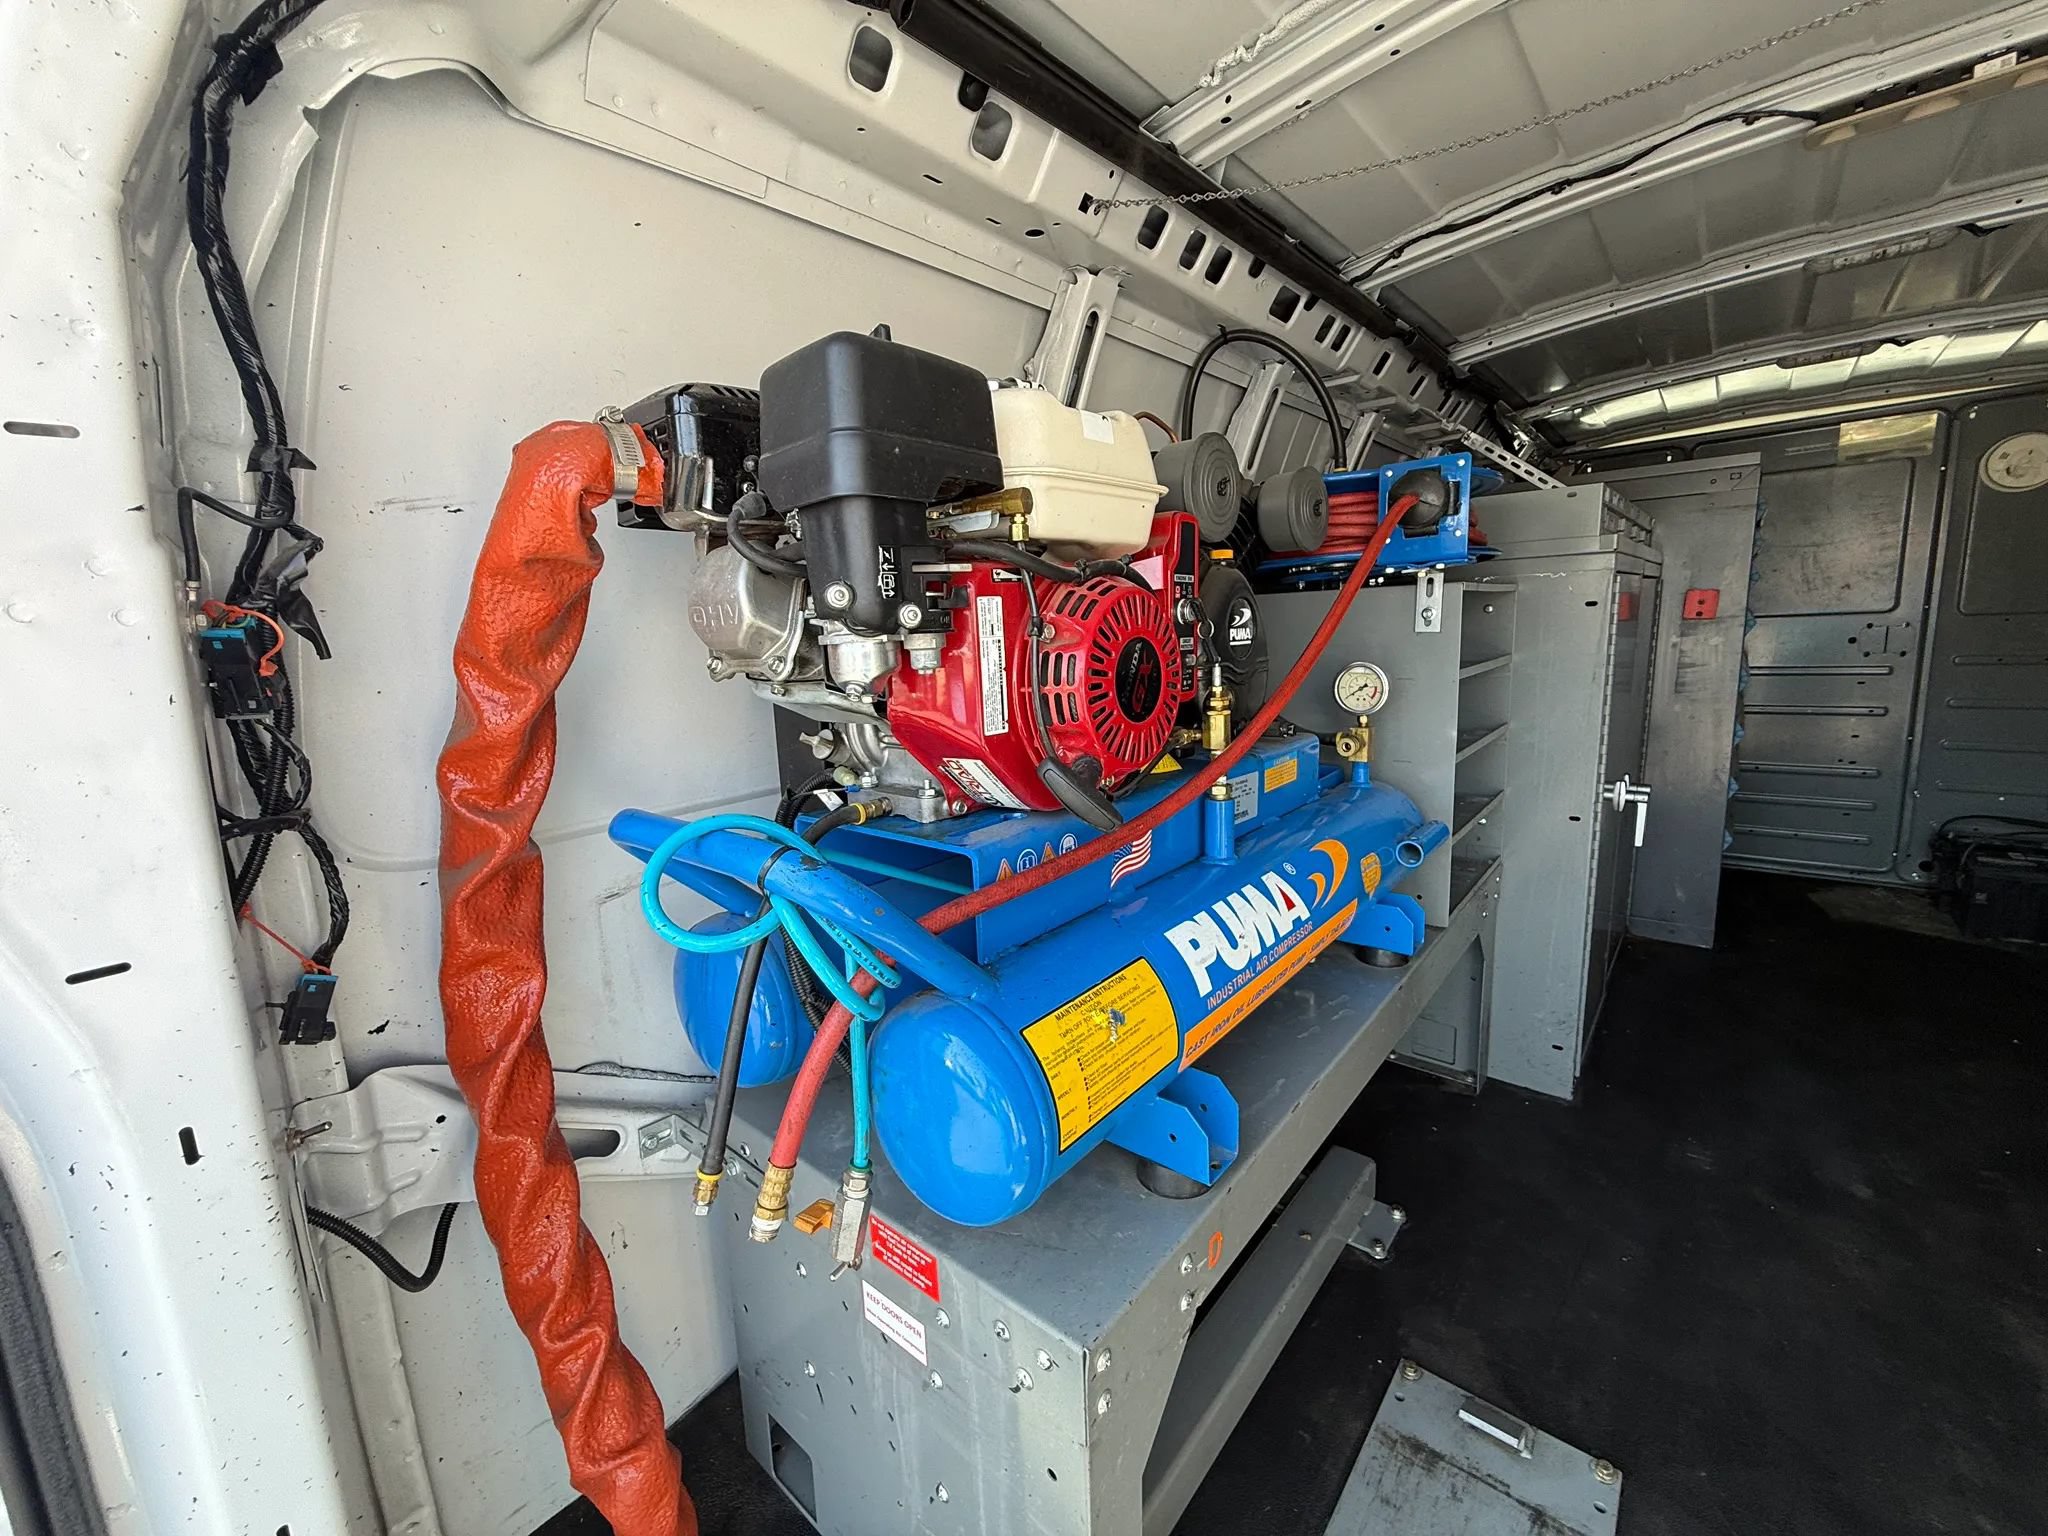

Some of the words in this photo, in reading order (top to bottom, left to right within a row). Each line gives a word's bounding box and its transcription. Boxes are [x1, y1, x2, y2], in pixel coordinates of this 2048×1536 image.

[1229, 627, 1253, 641] PUMA
[1163, 871, 1311, 998] PUMA
[1207, 966, 1255, 1010] INDUSTRIAL
[1256, 955, 1269, 973] AIR
[1269, 921, 1313, 962] COMPRESSOR
[1055, 991, 1093, 1021] MAINTENANCE
[1091, 974, 1127, 999] INSTRUCTIONS
[1072, 1019, 1083, 1030] OFF
[1117, 984, 1141, 1001] SERVICING
[866, 1292, 880, 1305] KEEP
[881, 1302, 903, 1325] DOORS
[904, 1320, 922, 1339] OPEN
